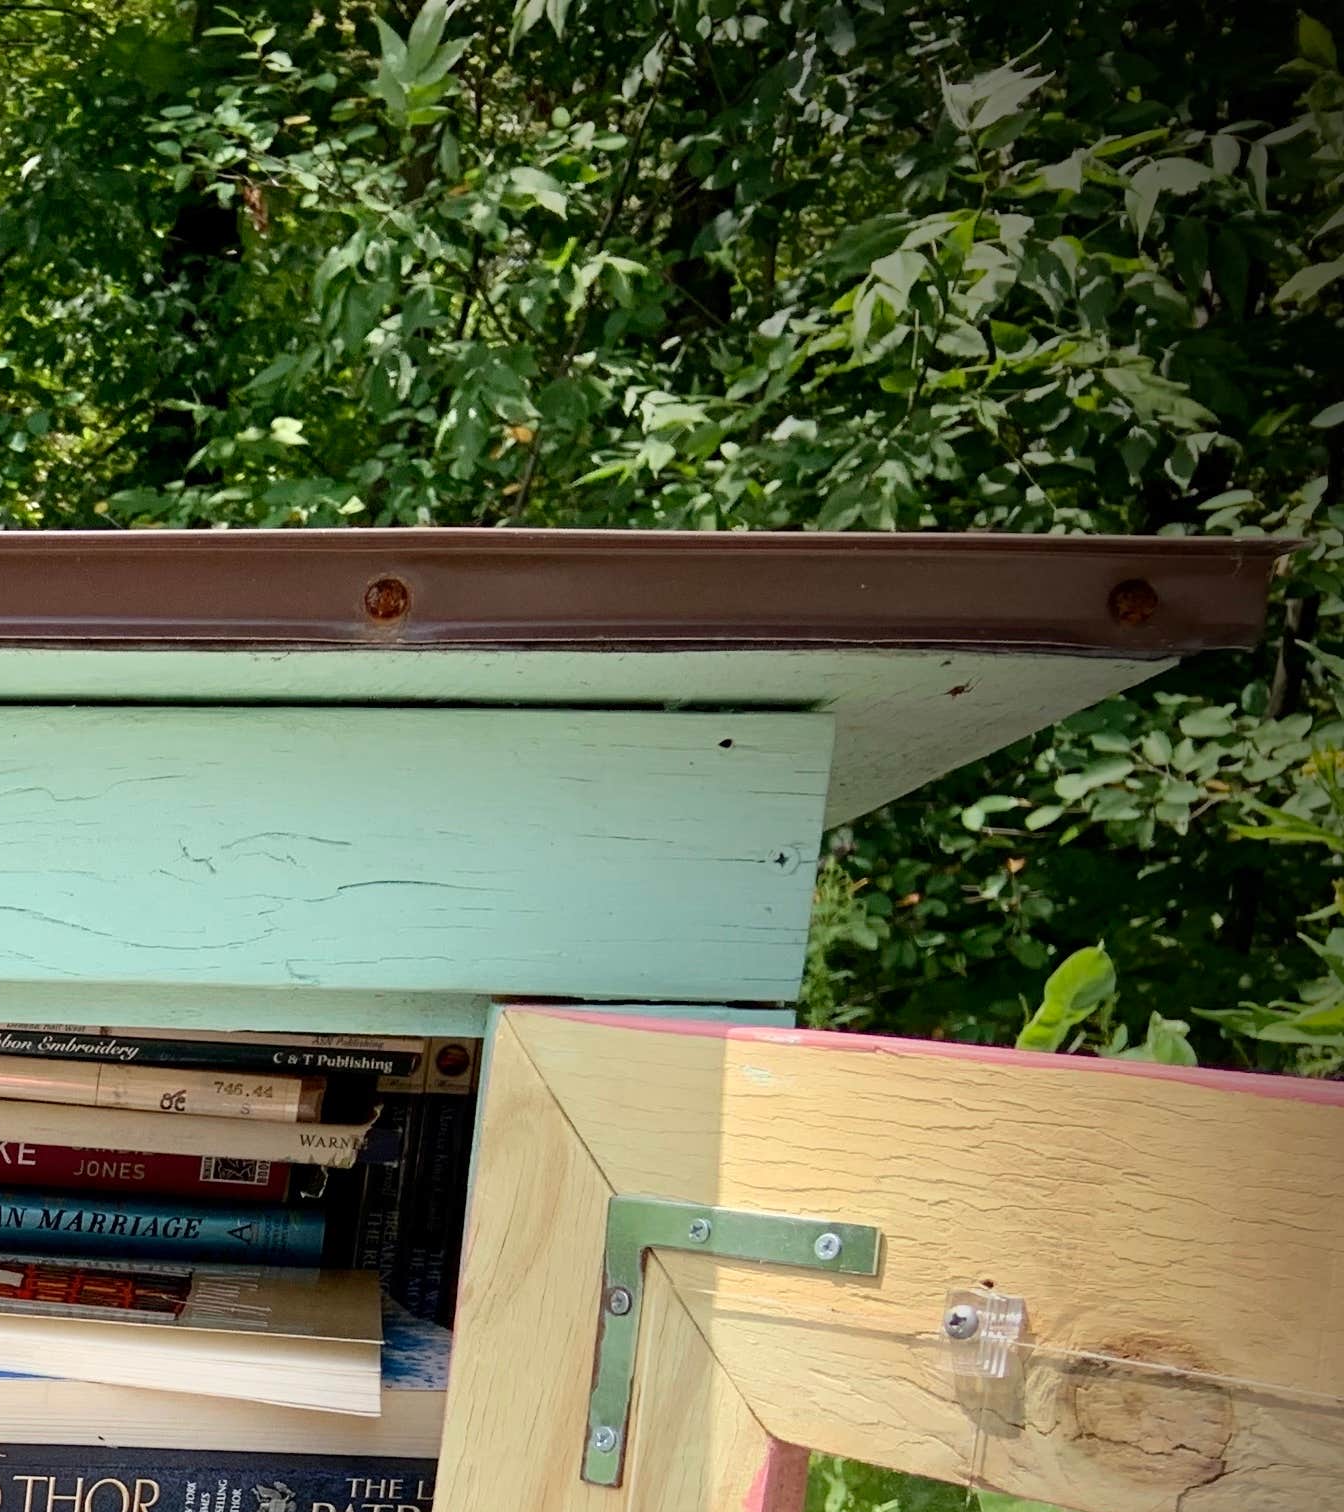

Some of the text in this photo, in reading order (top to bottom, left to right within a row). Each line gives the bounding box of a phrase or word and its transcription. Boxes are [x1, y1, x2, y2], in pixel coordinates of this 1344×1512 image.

[39, 1036, 138, 1060] Embroidery
[273, 1052, 393, 1072] C & T Publishing
[214, 1082, 273, 1098] 746.44
[73, 1159, 146, 1180] JONES
[38, 1209, 203, 1240] MARRIAGE
[346, 1478, 402, 1499] THE
